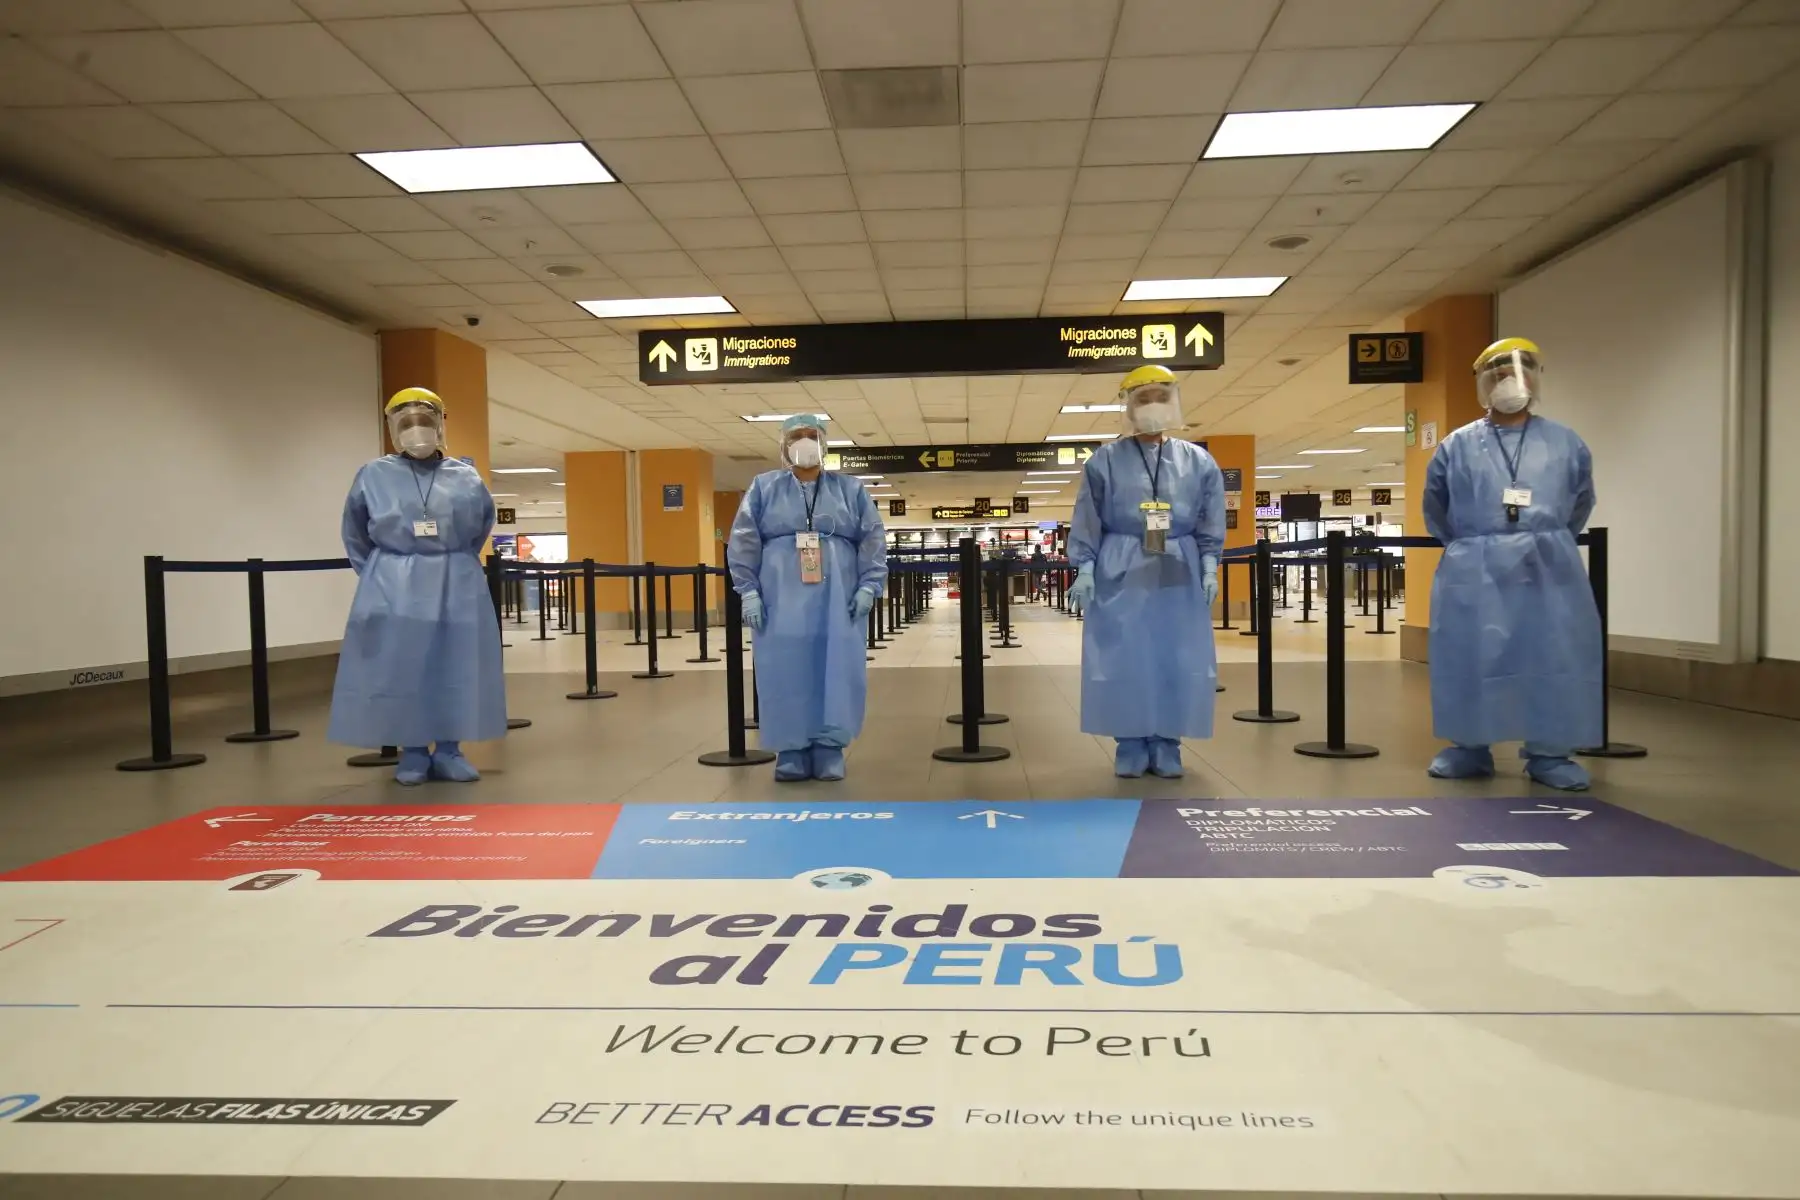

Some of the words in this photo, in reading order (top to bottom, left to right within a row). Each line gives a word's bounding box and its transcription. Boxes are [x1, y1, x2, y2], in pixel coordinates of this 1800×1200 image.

[1060, 326, 1137, 344] Migraciones
[723, 336, 797, 353] Migraciones
[1068, 345, 1137, 359] Immigrations
[724, 354, 790, 368] Immigrations
[842, 455, 867, 463] Puertas
[1256, 494, 1270, 505] 25
[1336, 492, 1351, 504] 26
[1375, 492, 1390, 503] 27
[891, 502, 904, 513] 19
[976, 501, 990, 511] 20
[1014, 500, 1028, 511] 21
[499, 511, 512, 522] 13
[69, 670, 124, 686] JCDecaux
[297, 813, 477, 823] Peruanos
[667, 809, 895, 822] Extranjeros
[1176, 806, 1433, 817] Preferencial
[638, 838, 748, 846] Foreigners
[367, 904, 1103, 938] Bienvenidos
[648, 943, 775, 987] al
[809, 935, 1183, 988] PERÚ
[604, 1025, 928, 1057] Welcome
[949, 1029, 1022, 1057] to
[1046, 1027, 1211, 1058] Perú
[206, 1103, 310, 1120] FILAS
[304, 1101, 432, 1121] ÚNICAS
[534, 1101, 734, 1127] BETTER
[736, 1105, 936, 1128] ACCESS
[964, 1108, 1066, 1127] Follow
[1073, 1110, 1122, 1127] the
[1131, 1112, 1233, 1131] unique
[1240, 1112, 1314, 1128] lines
